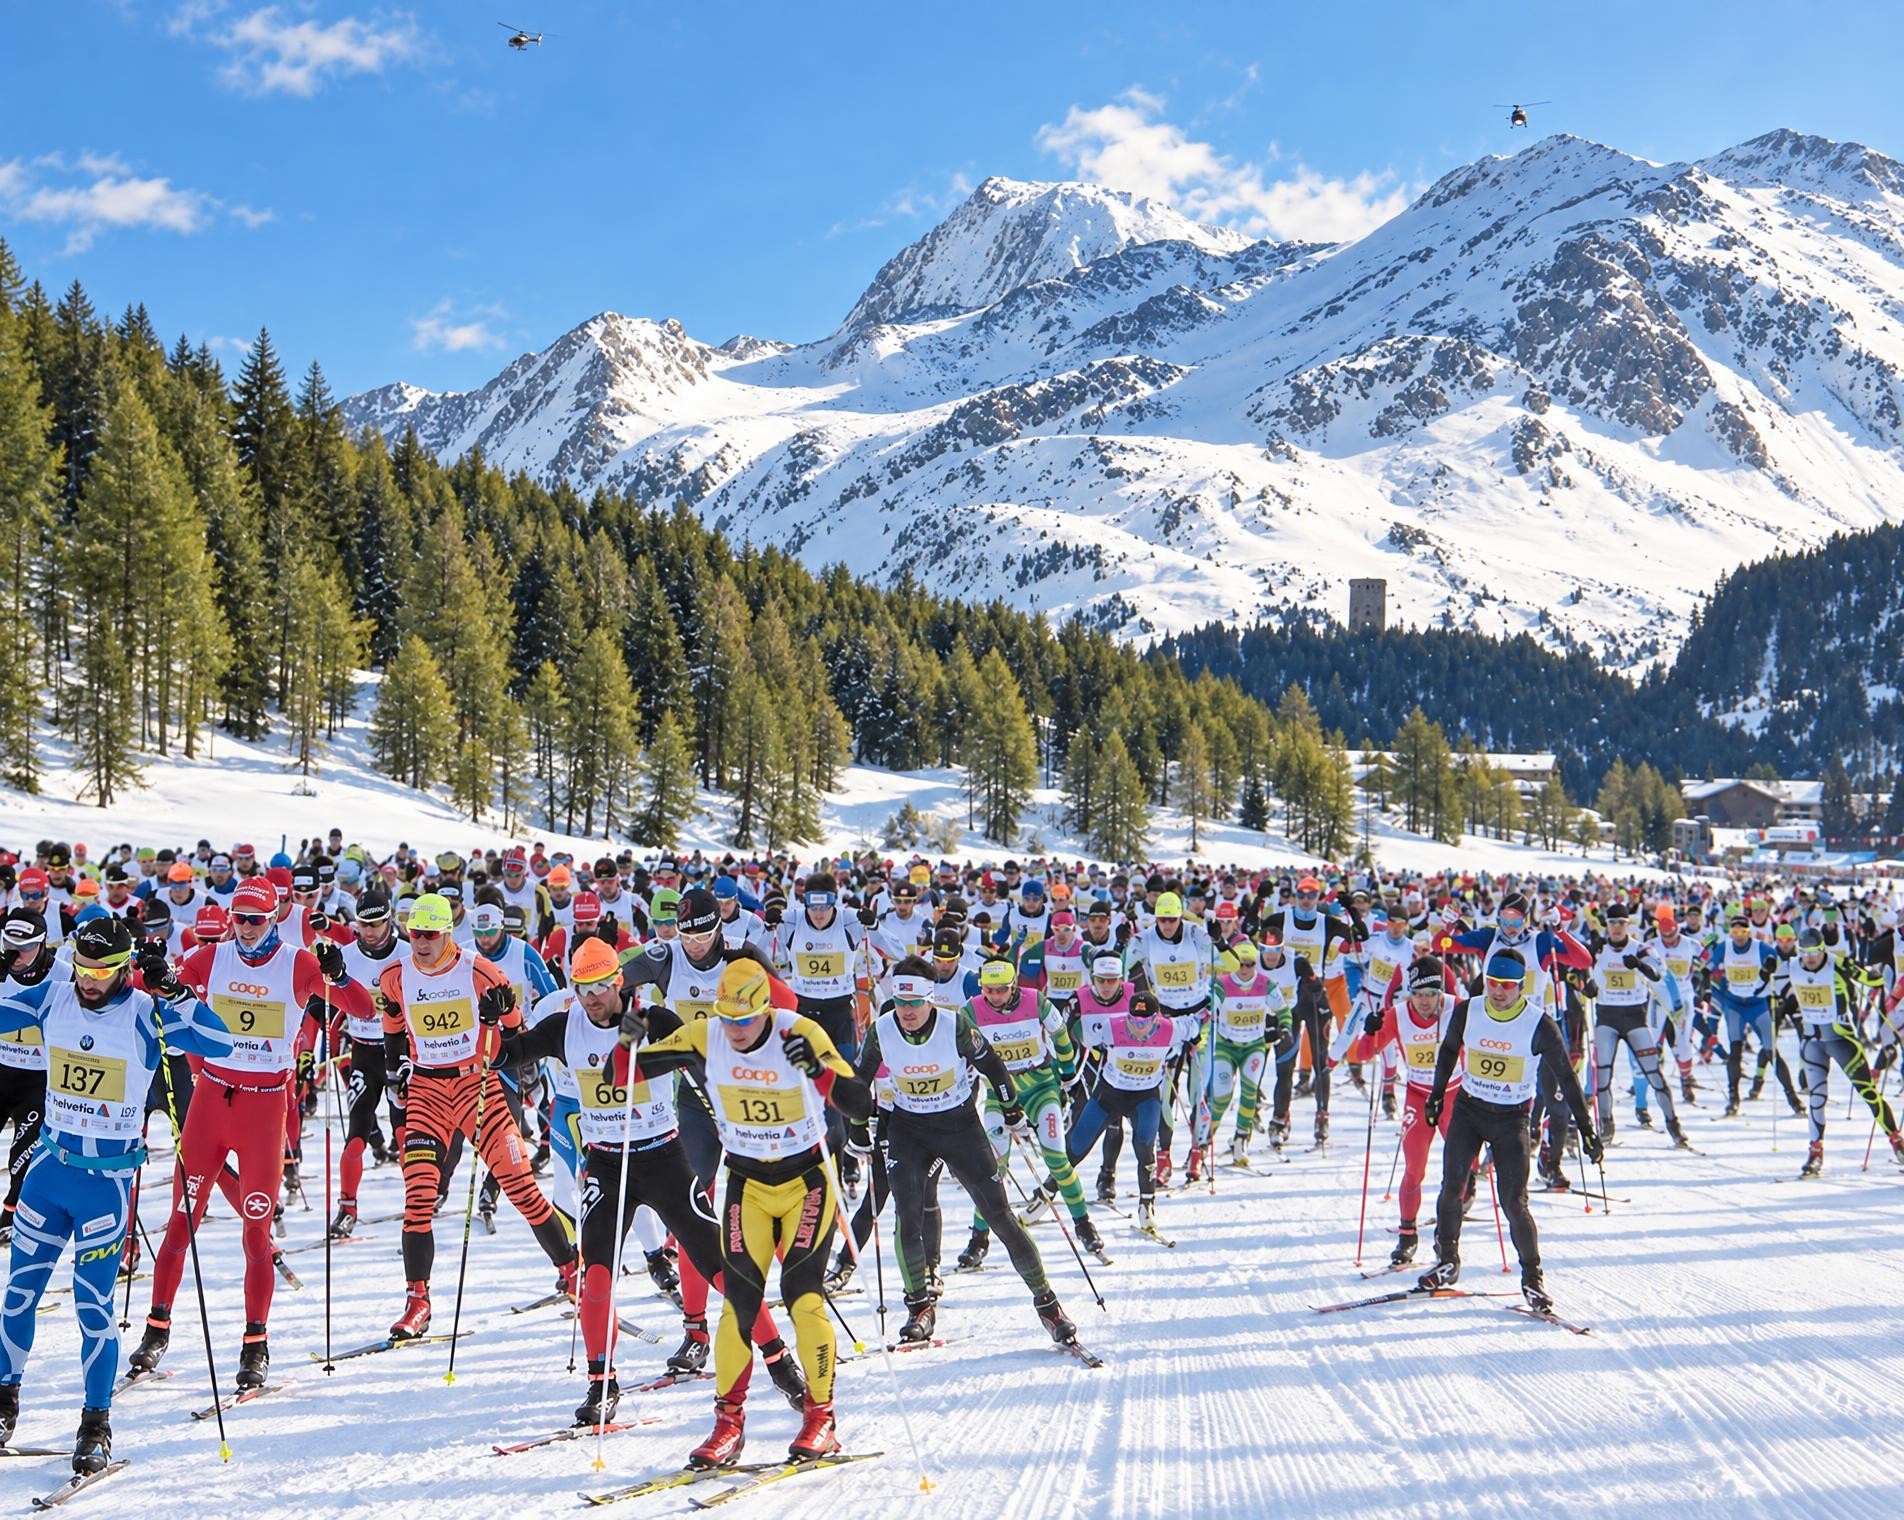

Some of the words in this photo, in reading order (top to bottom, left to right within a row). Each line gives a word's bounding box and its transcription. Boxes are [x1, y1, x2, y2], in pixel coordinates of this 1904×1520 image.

[808, 959, 832, 975] 94
[1163, 971, 1188, 983] 943
[228, 981, 269, 998] coop
[1802, 991, 1823, 1004] 791
[240, 1010, 255, 1032] 9
[423, 1011, 461, 1031] 942
[233, 1040, 259, 1050] vetia
[1480, 1038, 1512, 1051] coop
[732, 1065, 779, 1086] coop
[903, 1063, 940, 1075] coop
[1480, 1059, 1506, 1077] 99
[60, 1063, 106, 1095] 137
[907, 1078, 941, 1095] 127
[595, 1082, 628, 1105] 66
[53, 1095, 95, 1115] helvetia
[739, 1099, 785, 1123] 131
[735, 1127, 780, 1140] helvetia
